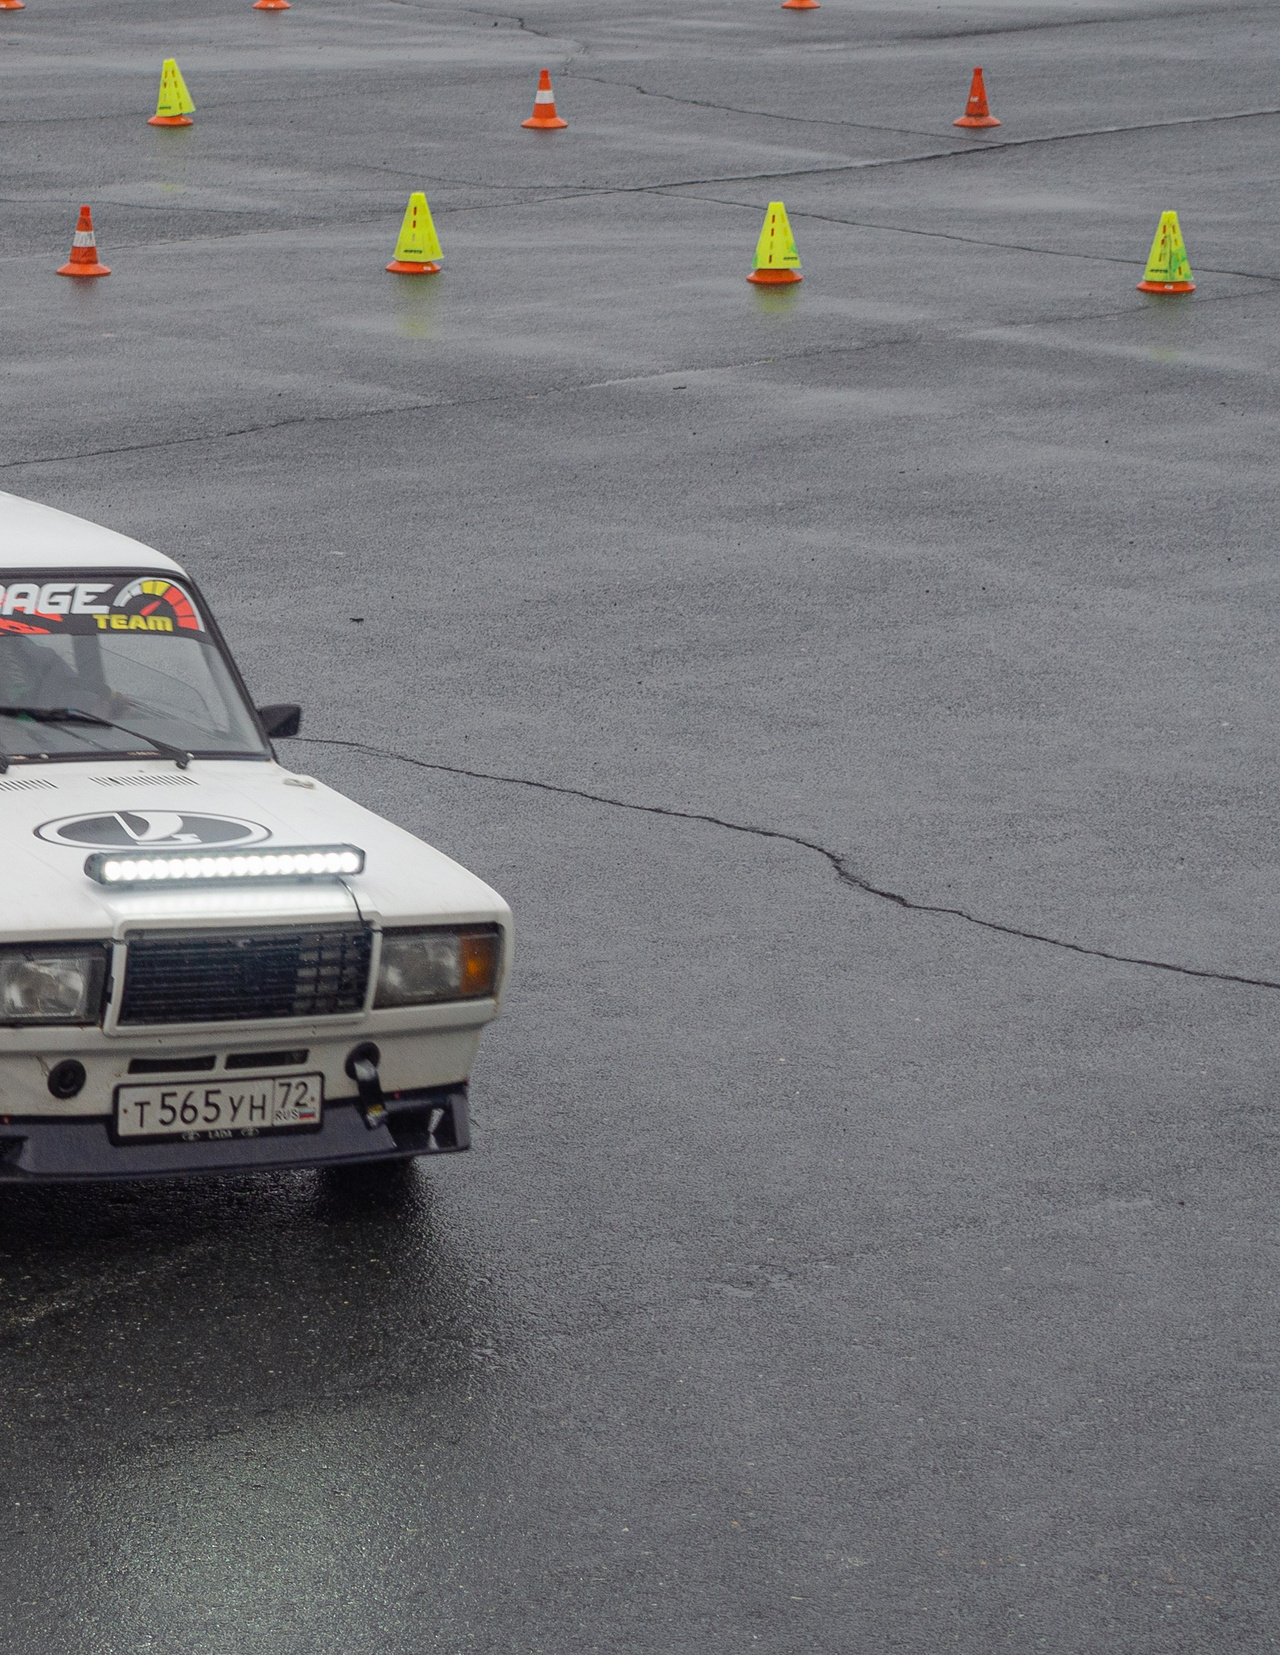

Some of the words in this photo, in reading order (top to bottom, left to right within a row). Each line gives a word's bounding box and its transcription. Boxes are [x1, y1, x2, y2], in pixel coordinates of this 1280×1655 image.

[92, 614, 174, 631] TEAM
[278, 1081, 309, 1108] 72
[275, 1108, 299, 1121] RUS
